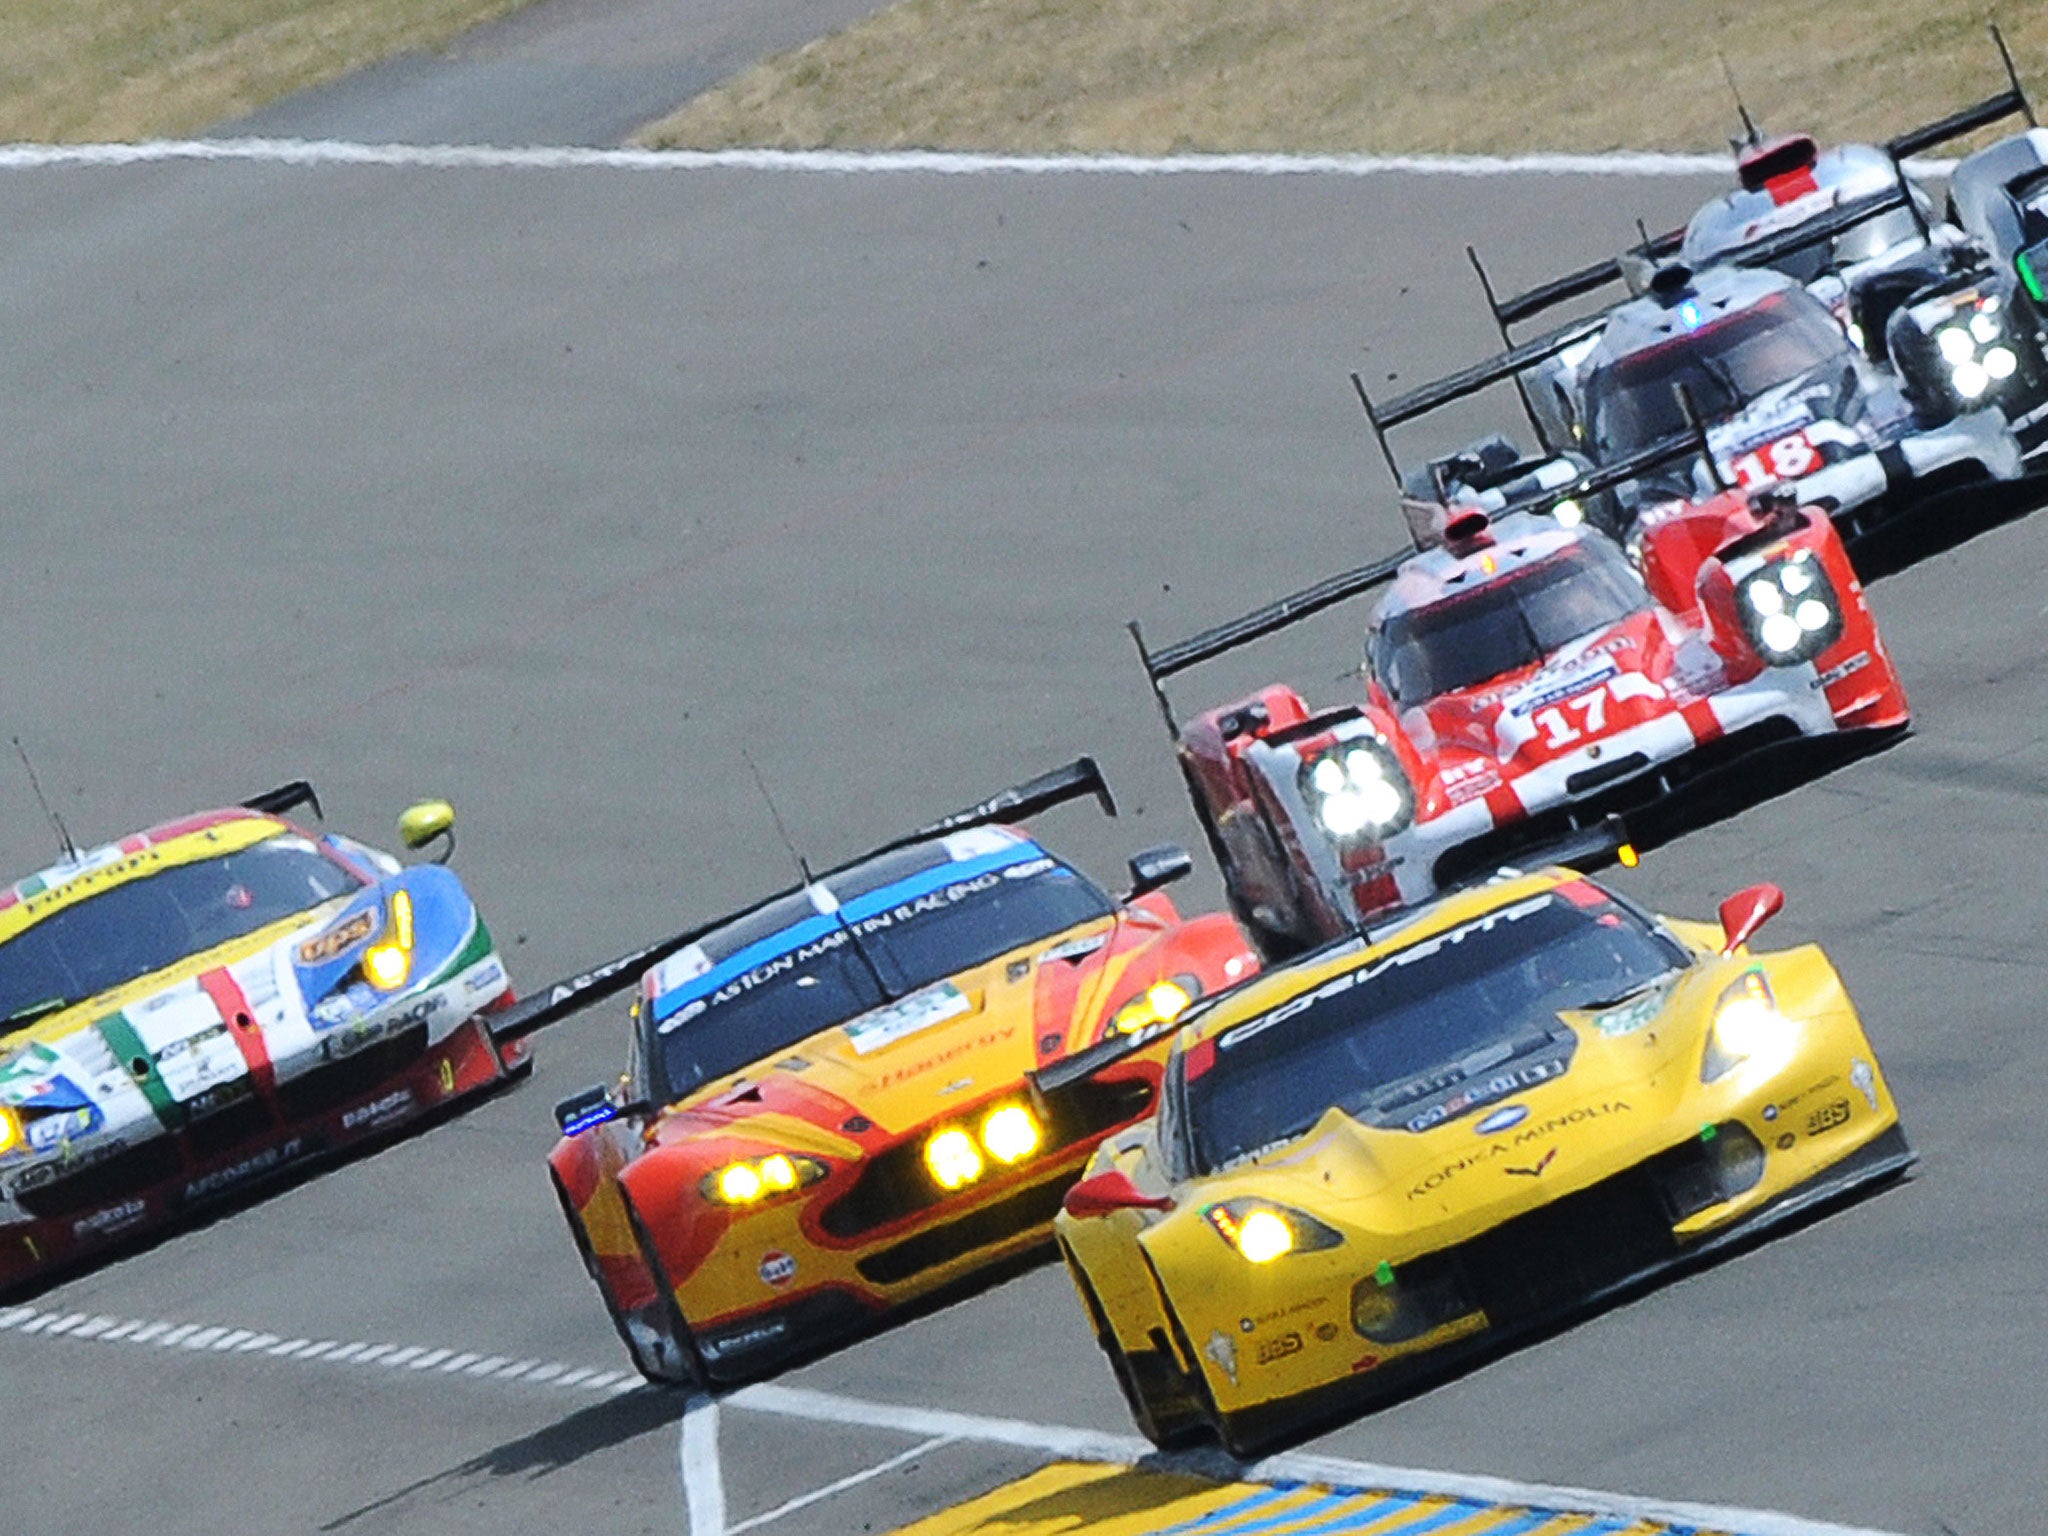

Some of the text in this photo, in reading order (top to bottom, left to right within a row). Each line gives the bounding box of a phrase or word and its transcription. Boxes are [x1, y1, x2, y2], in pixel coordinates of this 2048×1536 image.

[1733, 434, 1816, 491] 18
[1535, 686, 1608, 749] 17
[711, 955, 794, 1006] ASTON
[798, 910, 893, 962] MARTIN
[894, 873, 1001, 922] RACING
[1219, 893, 1552, 1049] CORVETTE
[1406, 1100, 1632, 1201] KONICA MINOLTA
